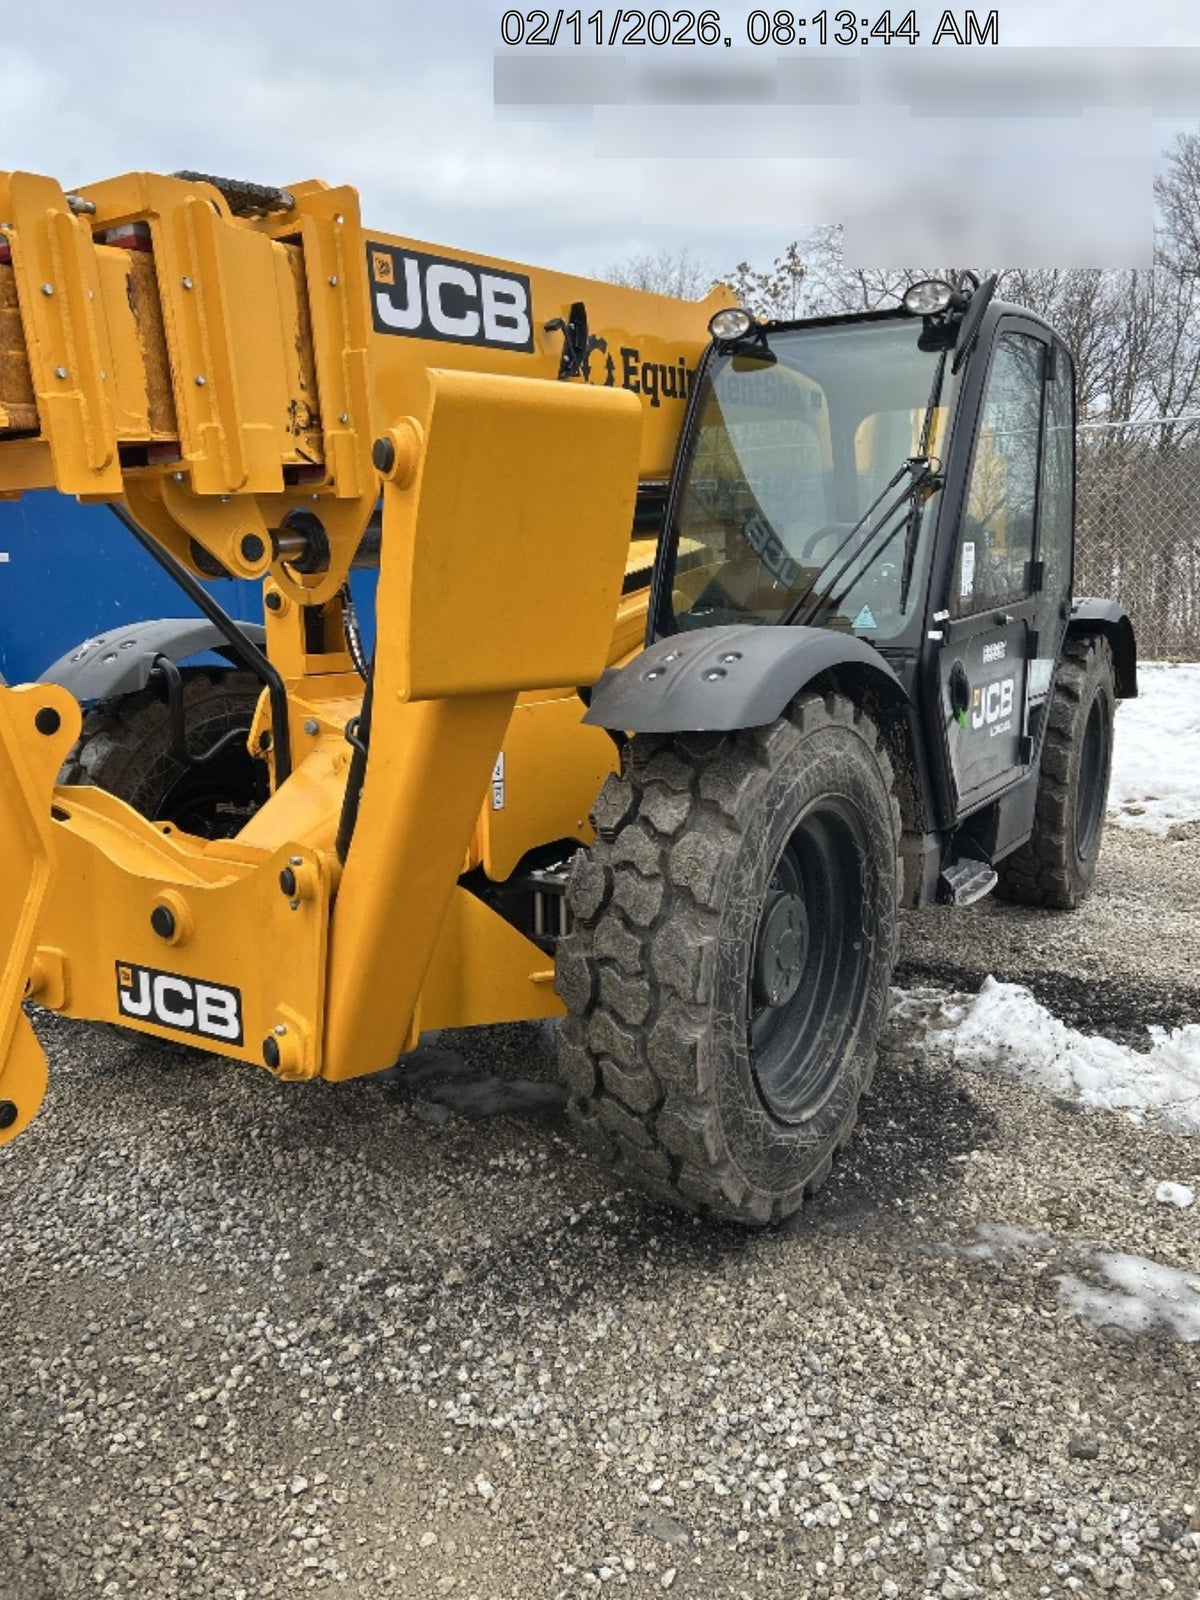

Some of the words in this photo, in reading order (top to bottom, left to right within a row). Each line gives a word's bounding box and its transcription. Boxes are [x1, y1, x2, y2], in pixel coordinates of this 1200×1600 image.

[376, 257, 530, 344] JCB
[972, 678, 1014, 730] JCB
[119, 969, 241, 1040] JCB
